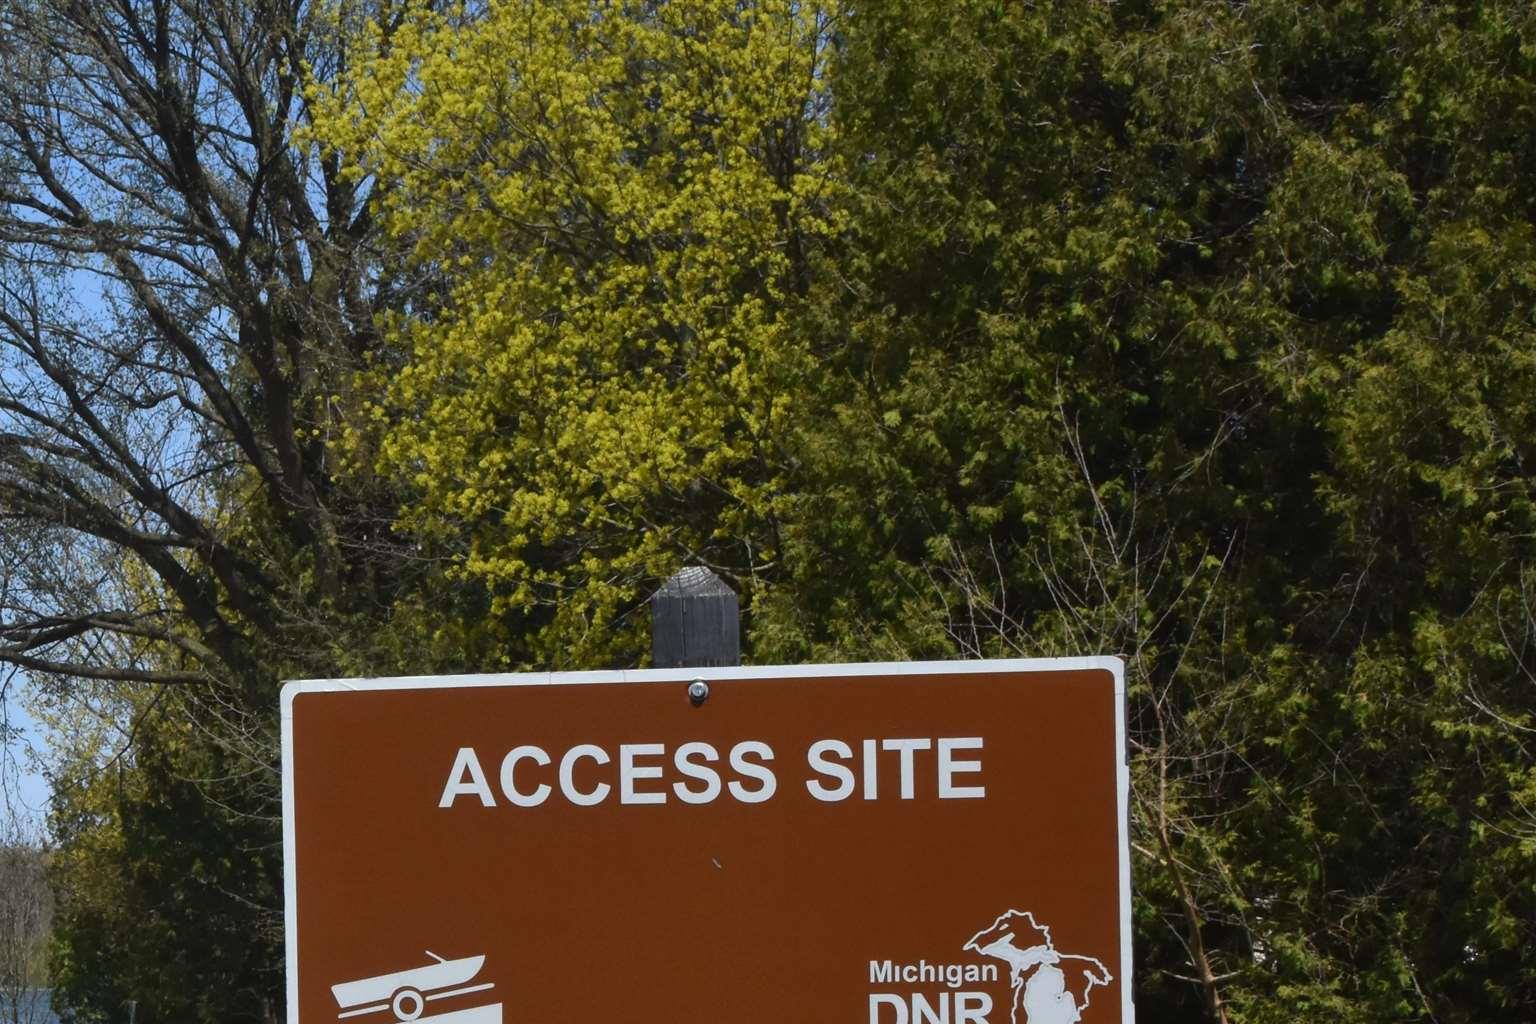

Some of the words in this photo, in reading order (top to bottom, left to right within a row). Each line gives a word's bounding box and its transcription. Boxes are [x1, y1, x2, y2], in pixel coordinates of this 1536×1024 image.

[439, 741, 776, 807] ACCESS
[806, 737, 985, 801] SITE
[870, 960, 997, 987] Michigan
